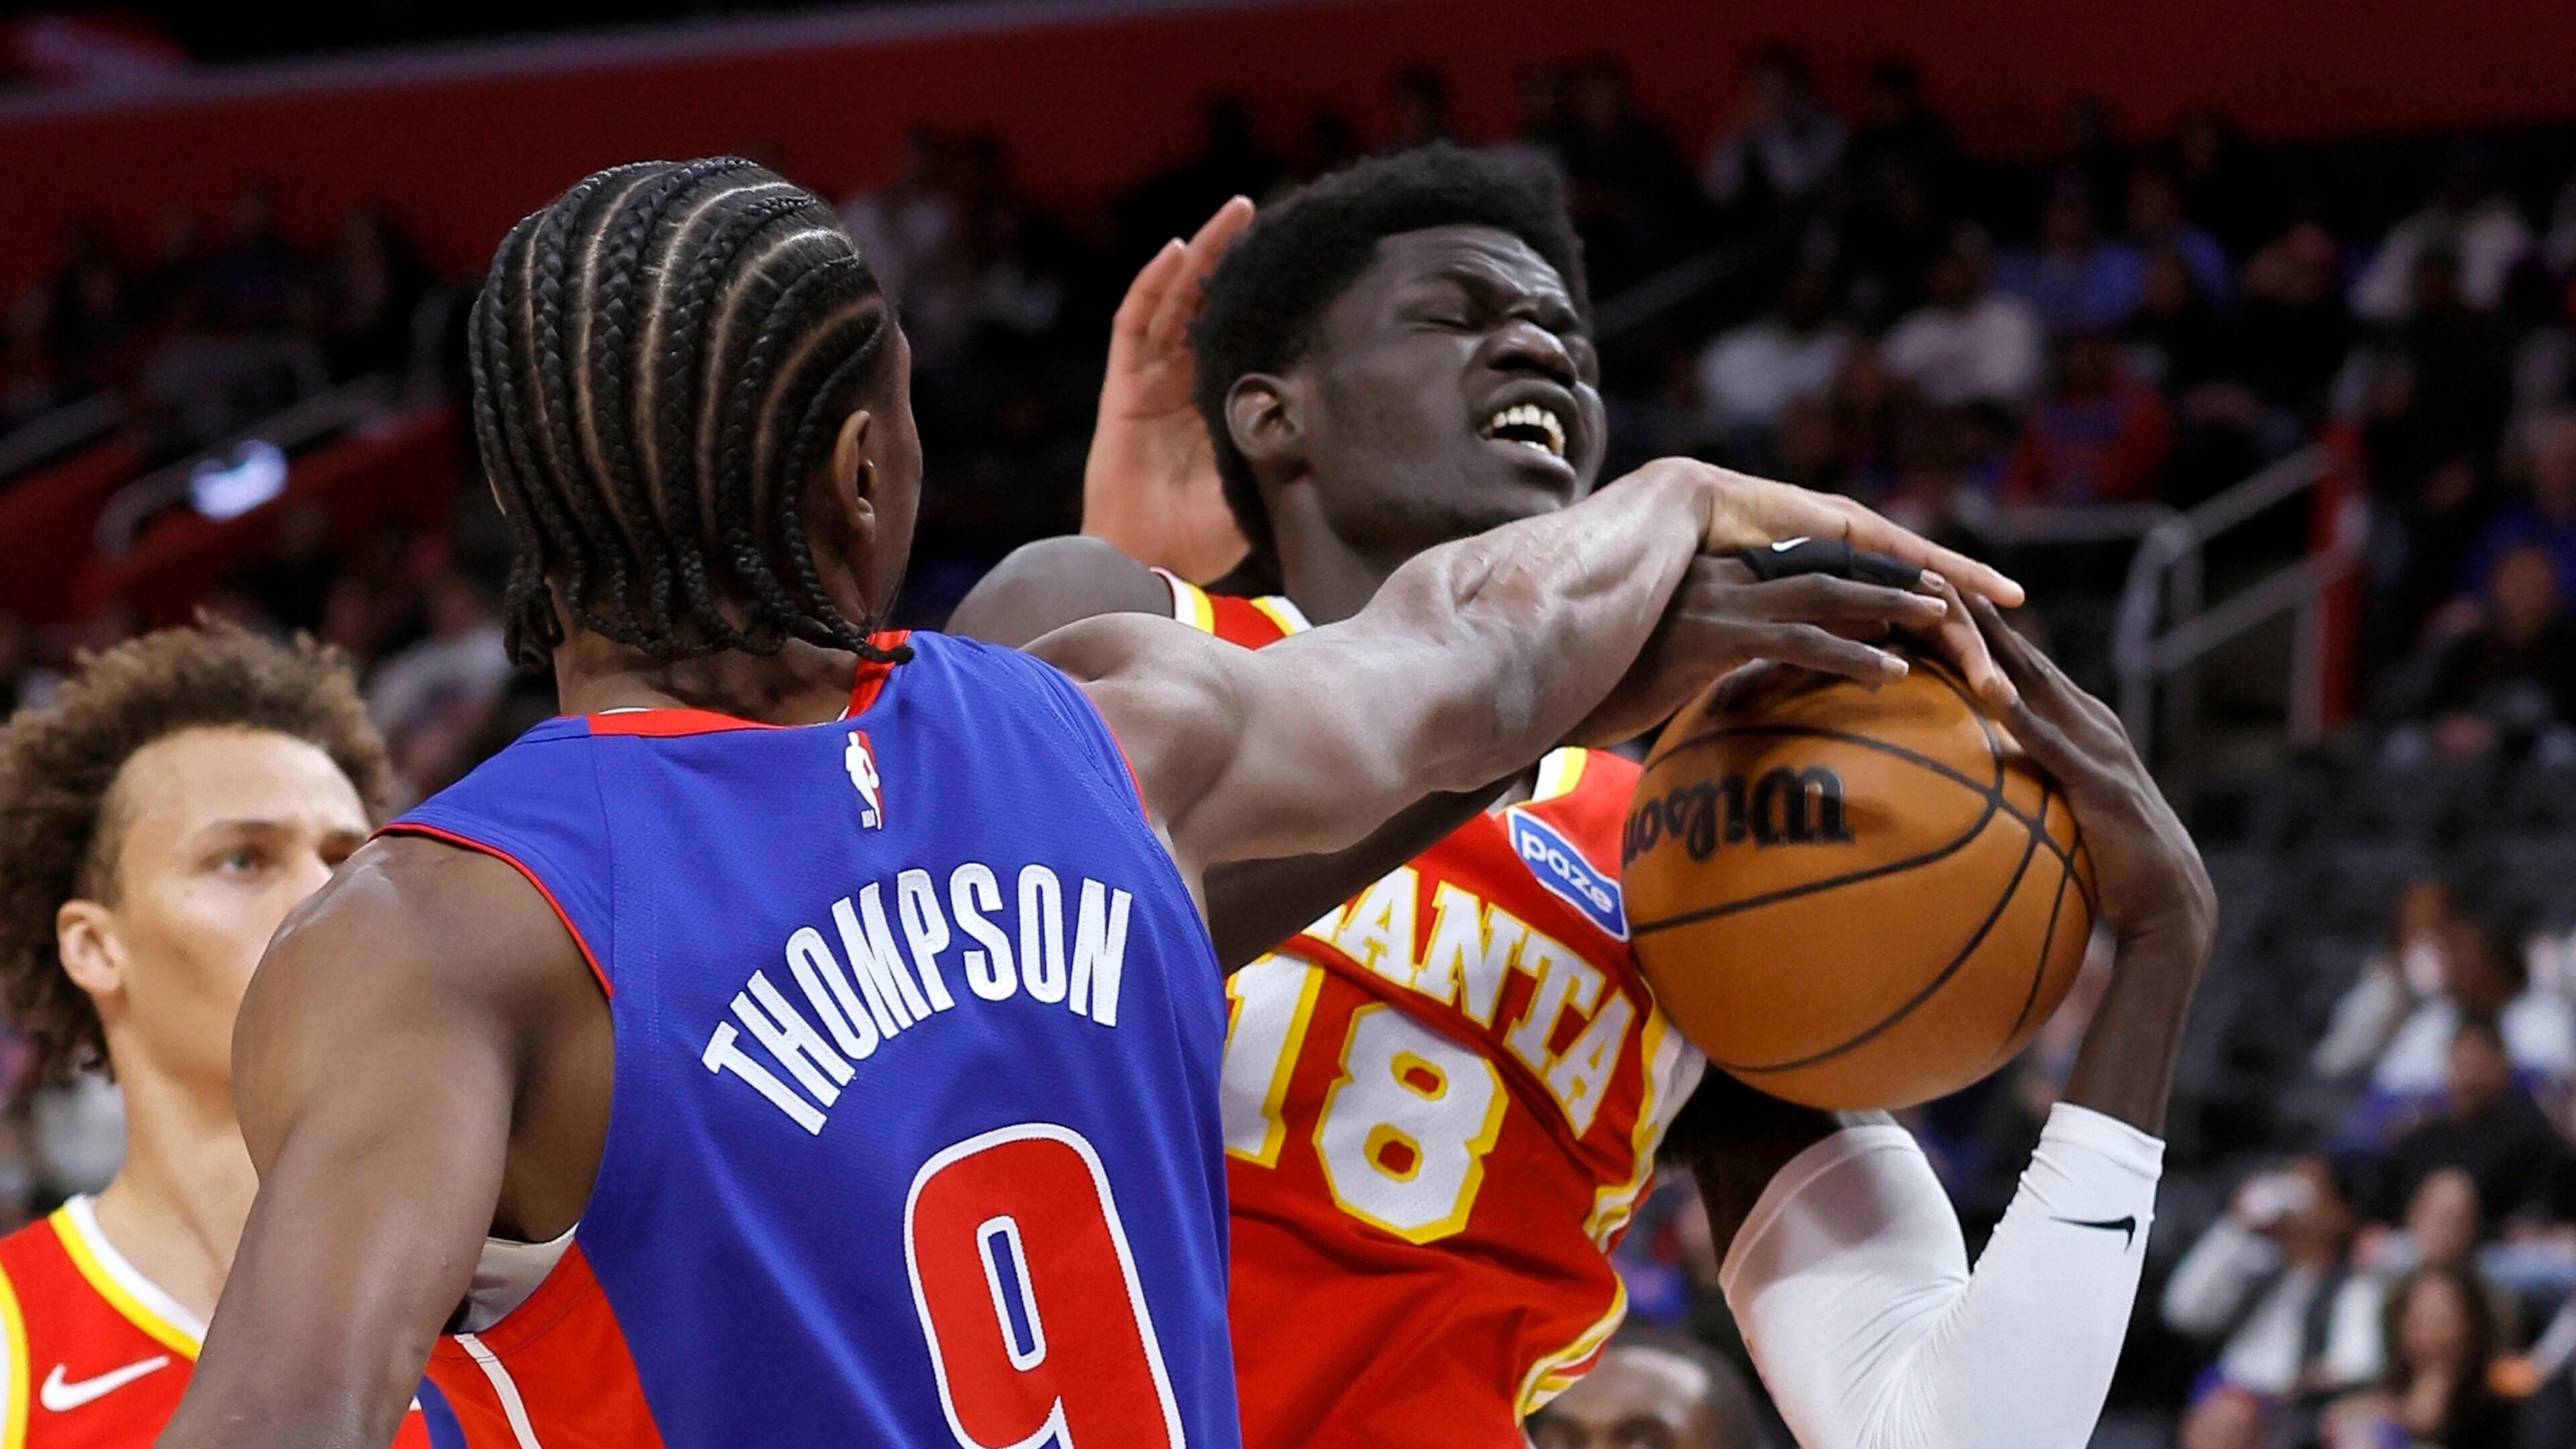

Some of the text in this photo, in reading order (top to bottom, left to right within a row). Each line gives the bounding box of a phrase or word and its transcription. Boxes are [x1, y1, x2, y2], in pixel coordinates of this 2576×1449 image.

[1521, 830, 1613, 914] paze
[1621, 765, 1854, 870] Wilson
[702, 863, 1132, 1136] THOMPSON
[1222, 951, 1510, 1246] 18
[904, 1122, 1186, 1449] 9
